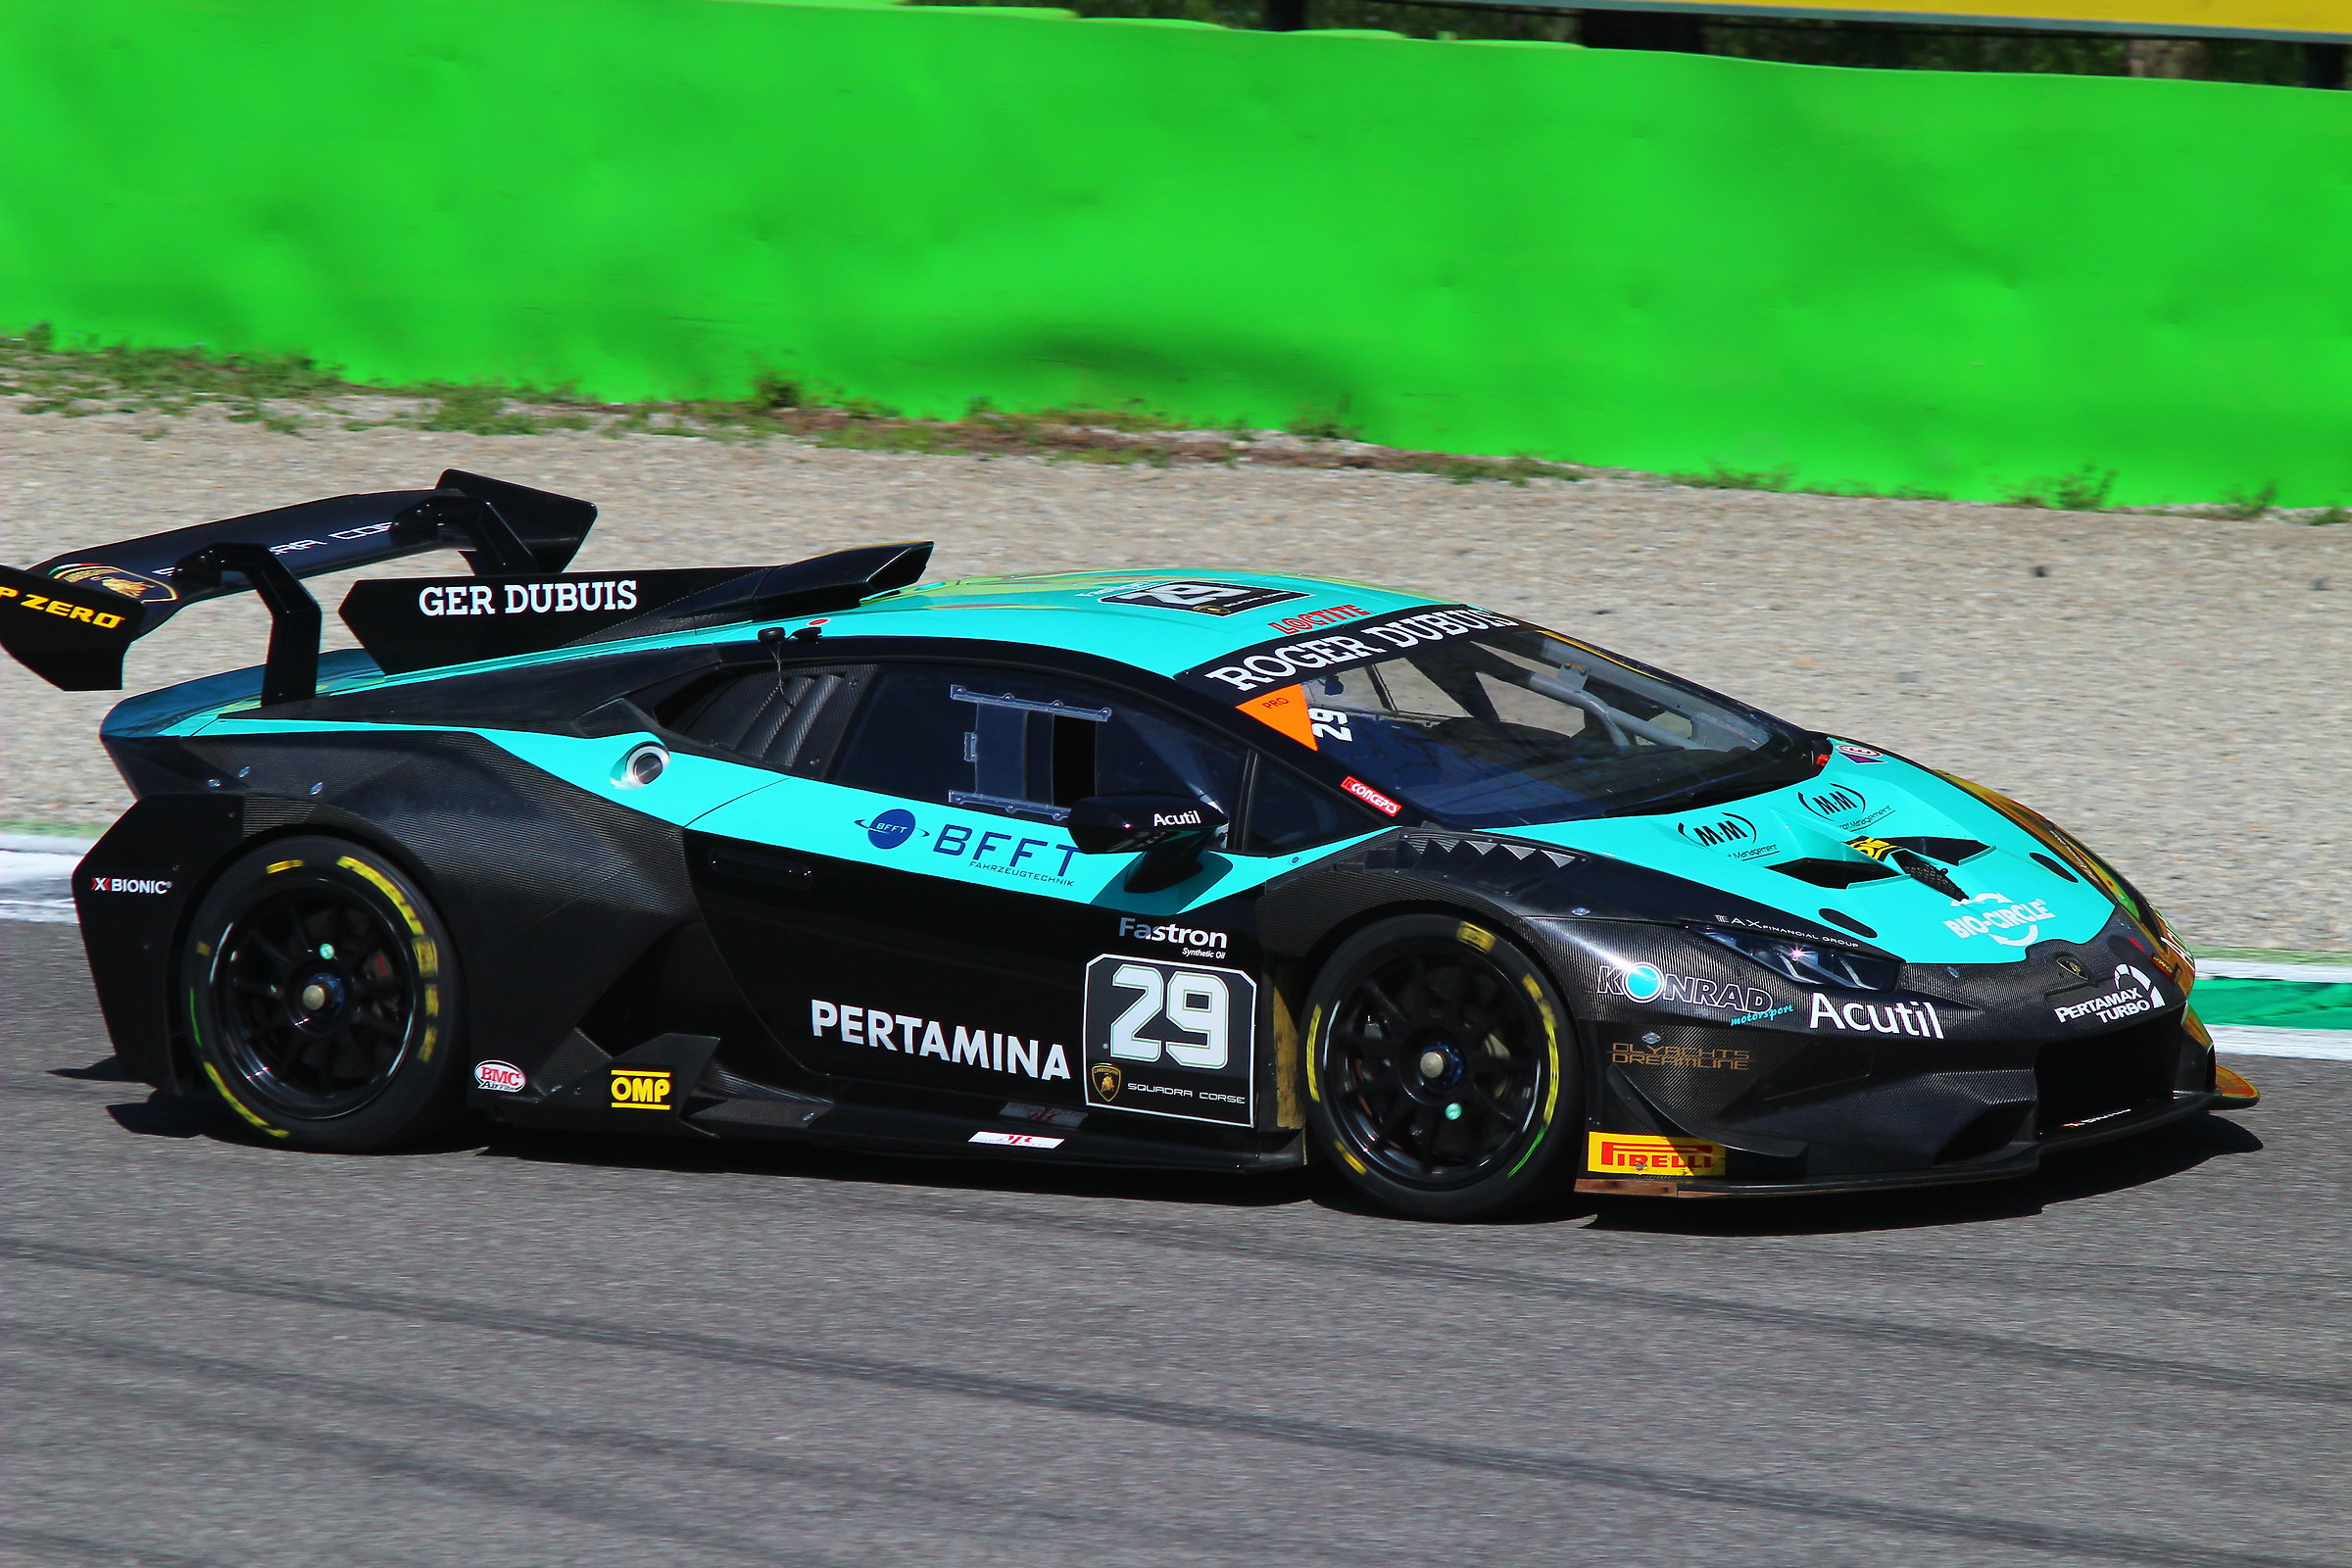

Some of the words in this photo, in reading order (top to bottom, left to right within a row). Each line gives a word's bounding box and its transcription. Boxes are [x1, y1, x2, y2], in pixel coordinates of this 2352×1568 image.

[21, 594, 124, 629] ZERO
[418, 586, 496, 616] GER
[504, 580, 637, 614] DUBUIS
[1268, 604, 1370, 635] LOCTITE
[1204, 634, 1388, 692] ROGER
[1360, 609, 1520, 648] DUBUIS
[1261, 697, 1290, 710] PRO
[1307, 706, 1353, 743] 29
[875, 822, 907, 834] BFFT
[1153, 809, 1201, 827] Acutil
[933, 823, 1082, 877] BFFT
[969, 860, 1075, 887] FAHRZEUGTECHNIK
[1118, 916, 1228, 949] Fastron
[1942, 901, 2056, 939] BIO-CIRCLE
[1182, 948, 1215, 958] Synthetic
[1215, 951, 1226, 959] Oil
[1823, 936, 1859, 948] GROUP
[1596, 961, 1774, 1013] KONRAD
[1110, 963, 1230, 1070] 29
[1730, 1004, 1794, 1027] motorsport
[1808, 992, 1945, 1040] Acutil
[2053, 987, 2143, 1023] PERTAMAX
[2095, 1000, 2151, 1023] TURBO
[810, 999, 1071, 1081] PERTAMINA
[480, 1066, 519, 1086] BMC
[611, 1076, 670, 1102] OMP
[1127, 1082, 1194, 1098] SQUADRA
[1199, 1092, 1246, 1104] CORSE
[1601, 1141, 1712, 1169] PIRELLI
